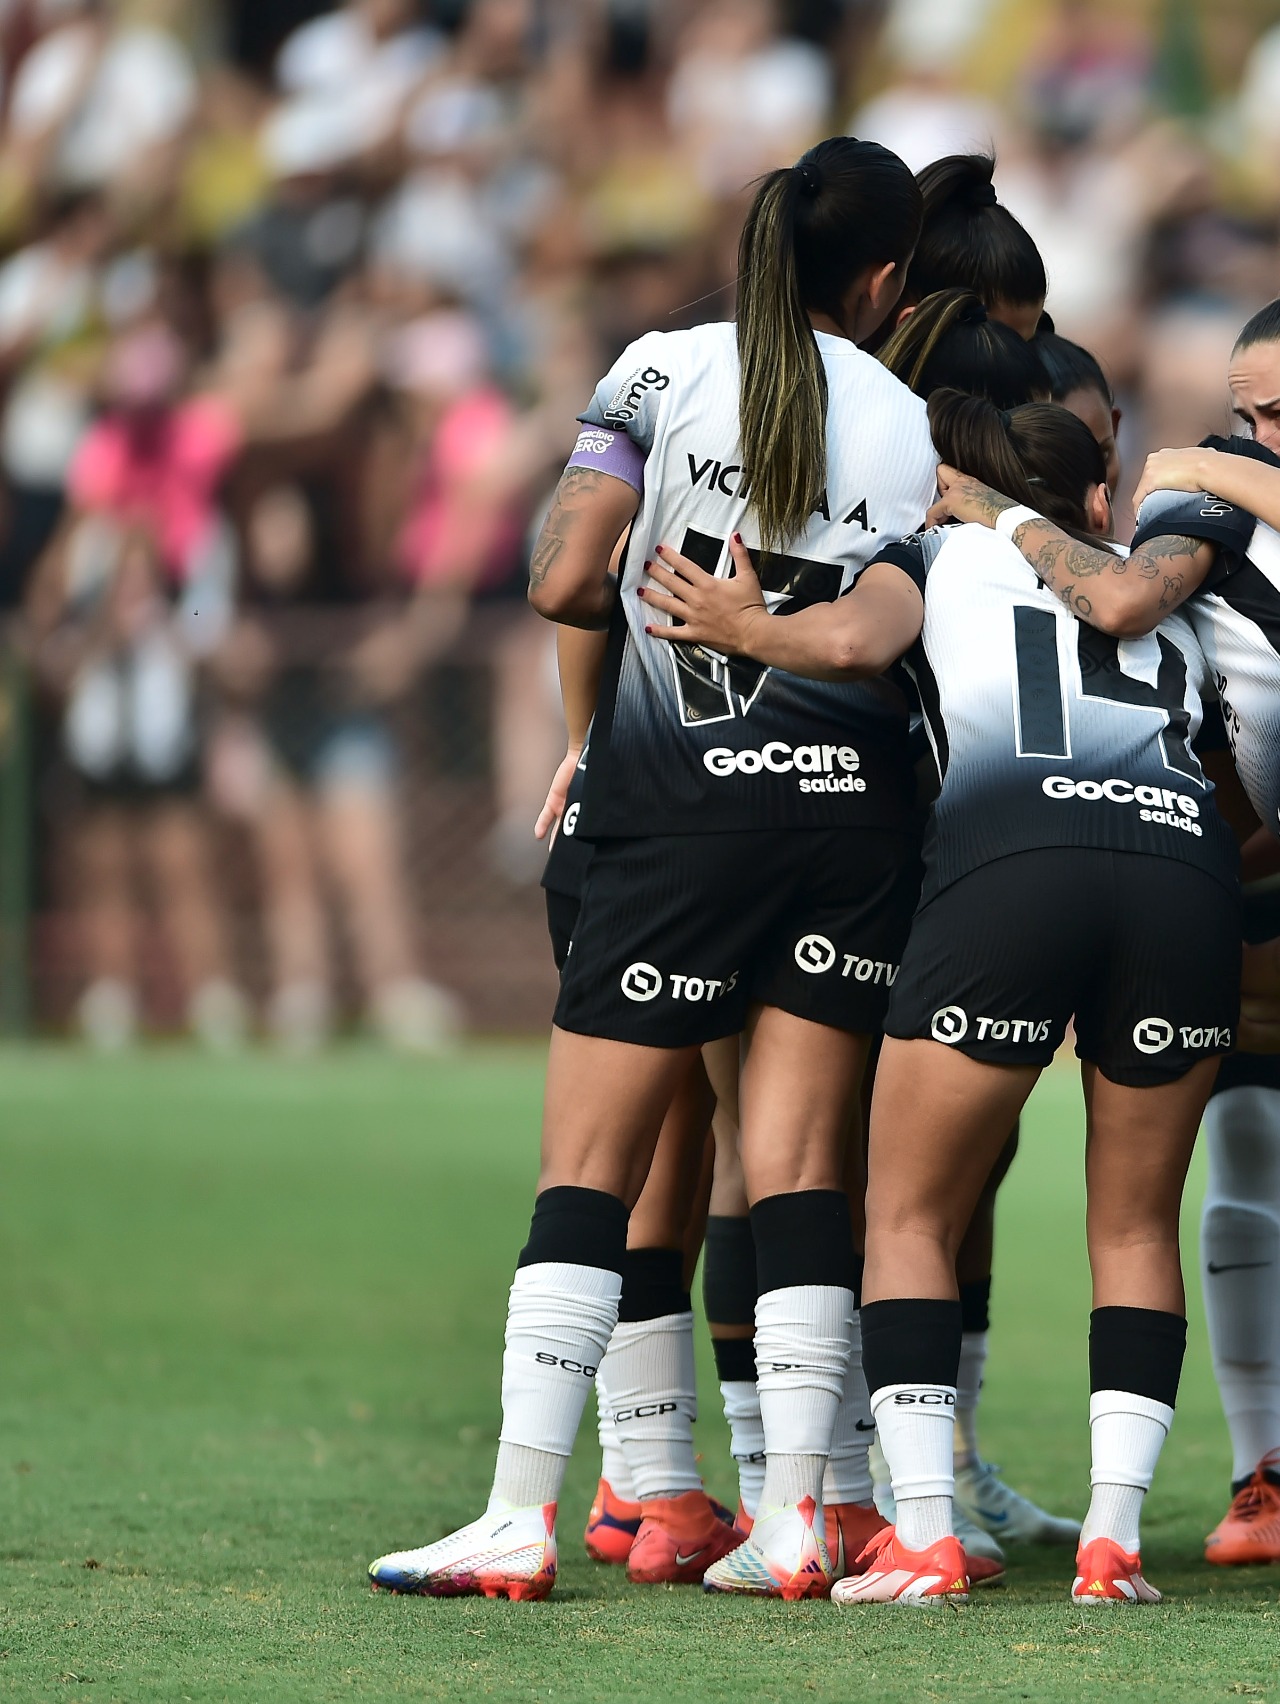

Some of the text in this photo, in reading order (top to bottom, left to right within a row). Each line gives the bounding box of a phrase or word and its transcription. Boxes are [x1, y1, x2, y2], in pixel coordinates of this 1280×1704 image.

[604, 366, 670, 422] bmg
[687, 452, 877, 534] VICA A.
[1011, 603, 1207, 791] 14
[703, 741, 860, 777] GoCare
[799, 774, 867, 793] saúde
[1041, 776, 1200, 818] GoCare
[1139, 808, 1203, 837] saúde
[841, 954, 901, 988] TOTV
[976, 1016, 1052, 1043] TOTVS
[535, 1351, 598, 1378] SCC
[613, 1402, 677, 1426] CCP
[893, 1393, 956, 1406] SCC
